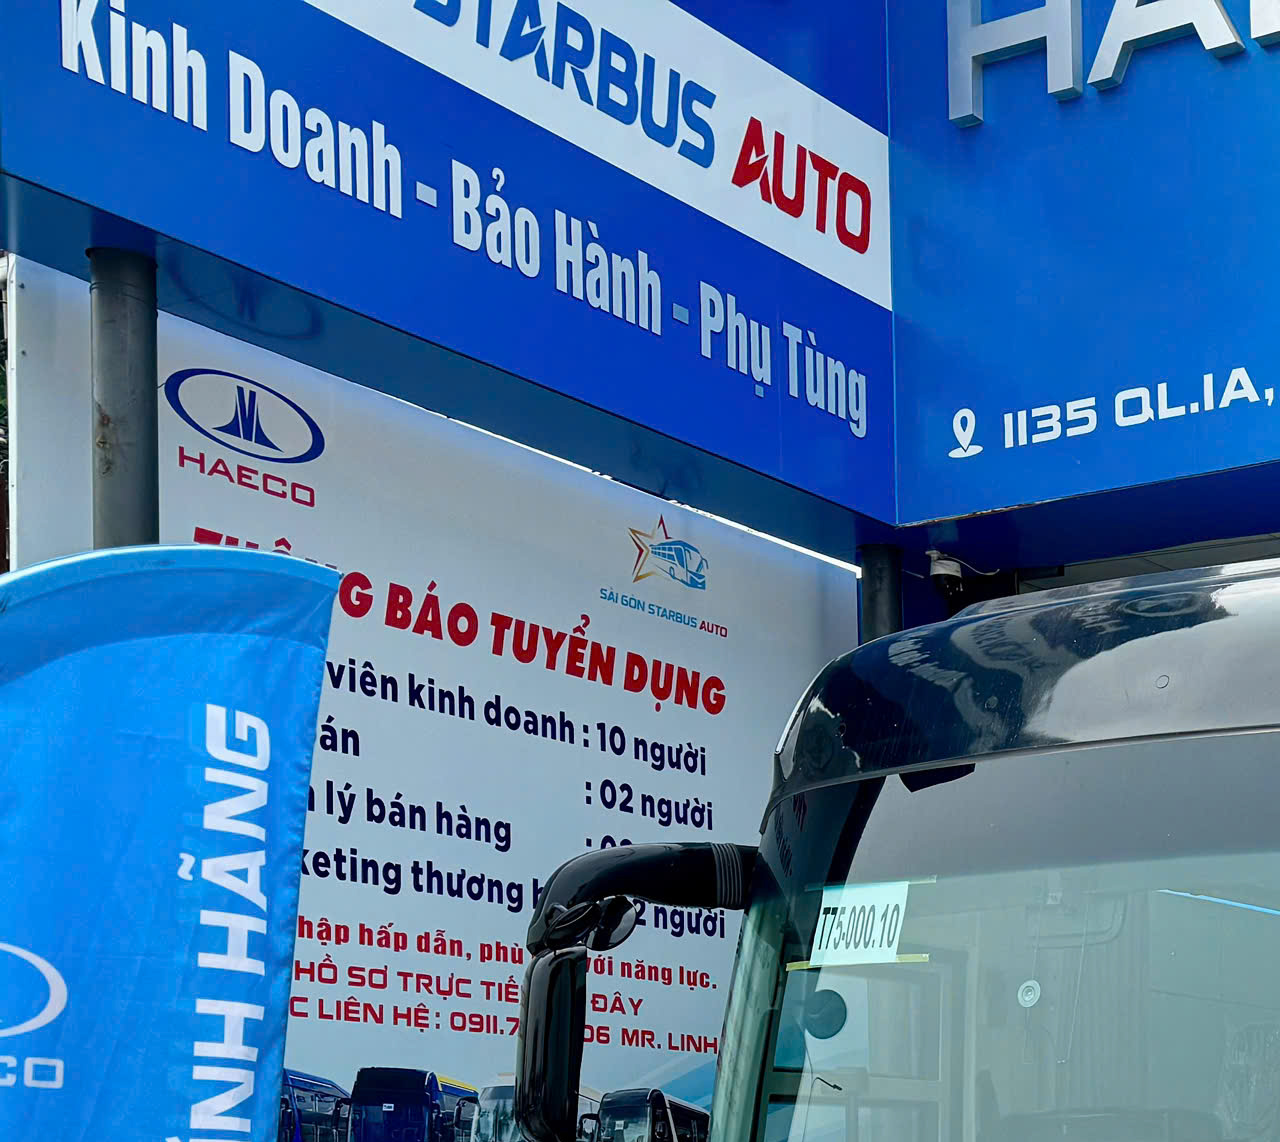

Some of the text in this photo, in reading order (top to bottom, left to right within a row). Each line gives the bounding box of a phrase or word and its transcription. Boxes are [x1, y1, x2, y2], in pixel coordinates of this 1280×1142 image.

[60, 0, 208, 132] Kinh
[229, 50, 403, 220] Doanh
[452, 158, 541, 279] Bảo
[555, 208, 664, 335] Hành
[700, 279, 773, 400] Phụ
[782, 320, 869, 438] Tùng
[732, 115, 872, 255] AUTO
[178, 445, 315, 508] HAECO
[384, 579, 728, 714] BÁO TUYỂN DỤNG
[648, 603, 698, 628] STARBUS
[699, 620, 729, 638] AUTO
[326, 658, 398, 703] viên
[408, 672, 476, 722] kinh
[483, 693, 576, 745] doanh
[596, 722, 626, 756] 10
[633, 736, 707, 777] người
[319, 716, 361, 758] án
[600, 779, 634, 814] 02
[641, 793, 713, 831] người
[176, 703, 272, 978] HÃNG
[326, 779, 357, 824] lý
[366, 788, 427, 832] bán
[435, 801, 512, 853] hàng
[411, 860, 524, 913] thương
[294, 953, 644, 1017] HỒ SƠ TRỰC TIẾ ĐÂY
[298, 915, 350, 947] hập
[359, 922, 408, 953] hấp
[416, 929, 472, 961] dẫn,
[480, 941, 524, 965] phù
[620, 959, 673, 986] năng
[679, 965, 718, 991] lực.
[289, 996, 309, 1018] C
[318, 995, 384, 1026] LIÊN
[450, 1011, 521, 1037] 0911.7
[621, 1028, 662, 1050] MR.
[668, 1033, 718, 1054] LINH
